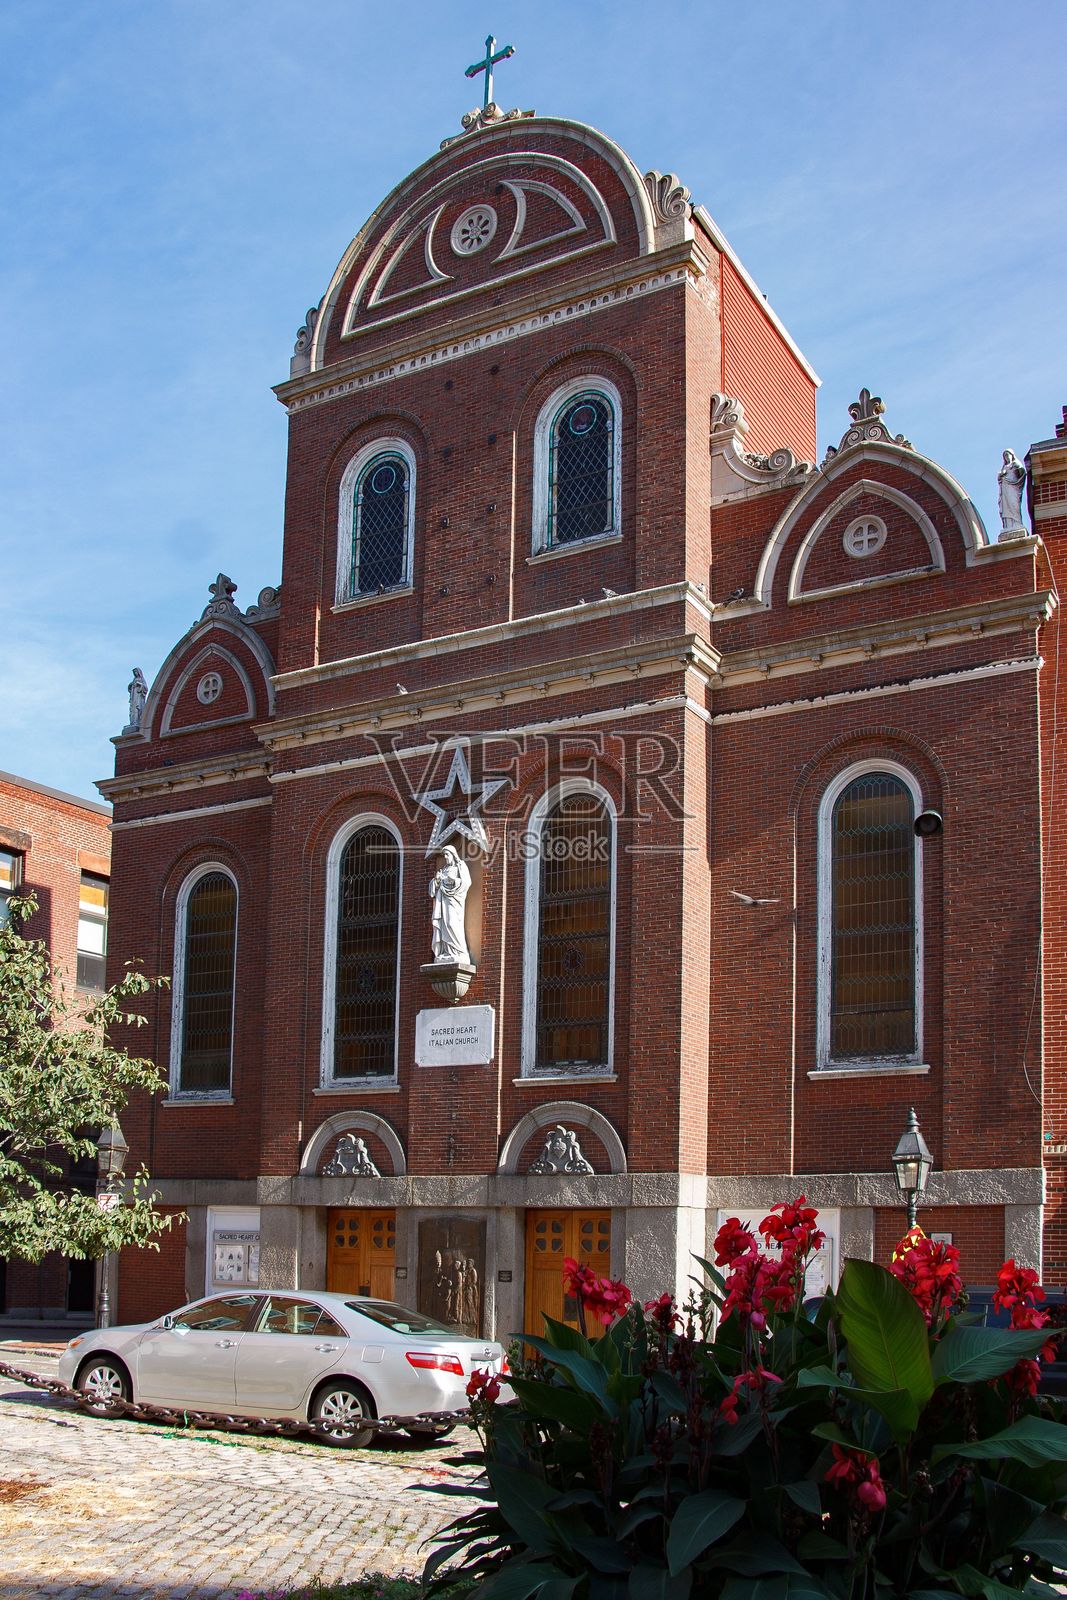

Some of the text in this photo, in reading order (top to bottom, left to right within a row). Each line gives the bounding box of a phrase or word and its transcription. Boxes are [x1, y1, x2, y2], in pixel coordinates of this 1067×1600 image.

[431, 1026, 477, 1036] SACRED HEART
[428, 1037, 479, 1047] ITALIAN CHURCH
